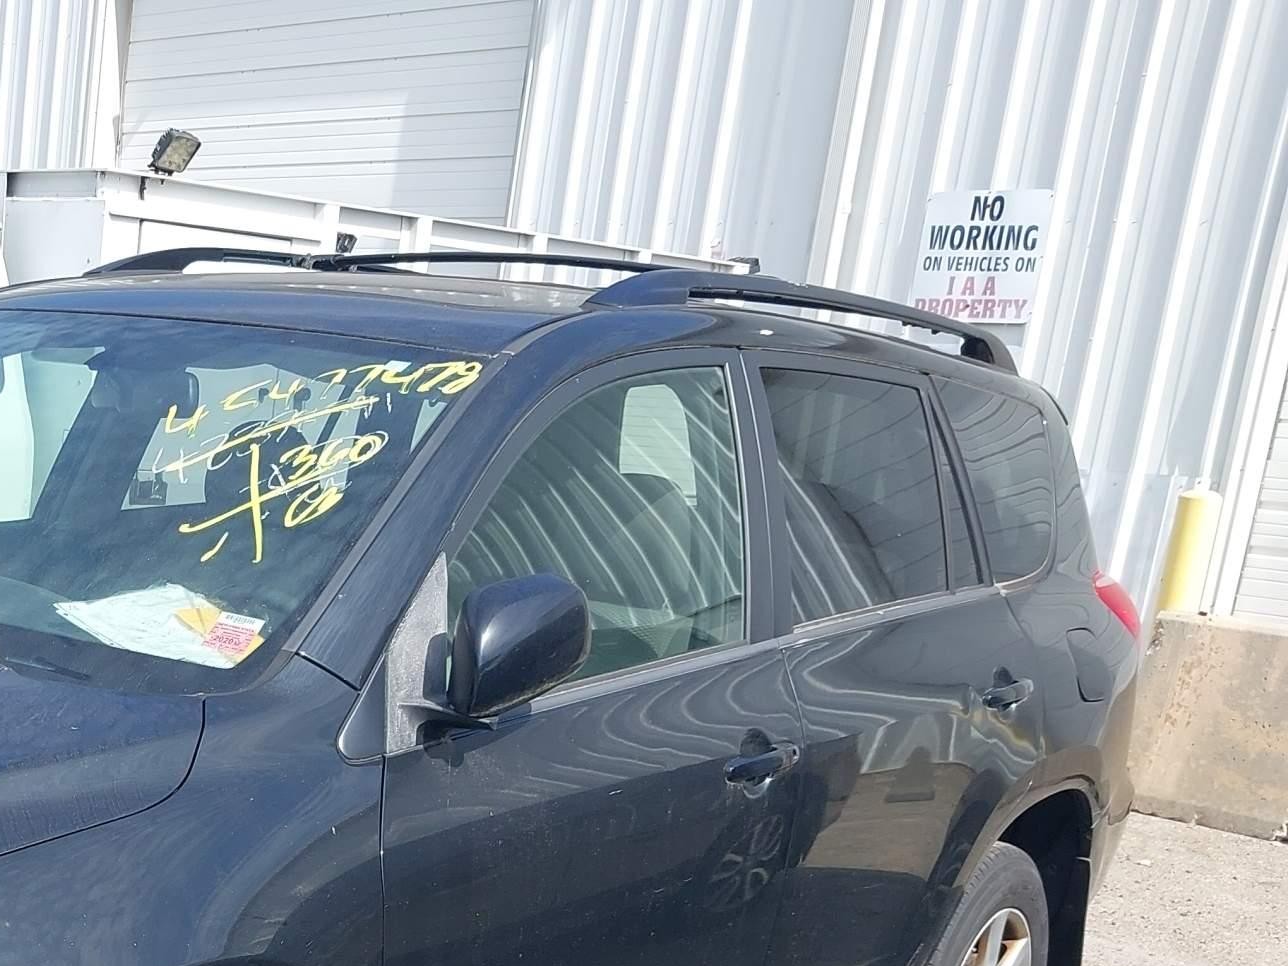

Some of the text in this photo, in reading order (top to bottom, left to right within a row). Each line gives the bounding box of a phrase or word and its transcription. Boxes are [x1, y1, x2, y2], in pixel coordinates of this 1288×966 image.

[970, 195, 1005, 221] NO
[928, 225, 1039, 251] WORKING
[922, 256, 1037, 273] ON VEHICLES ON
